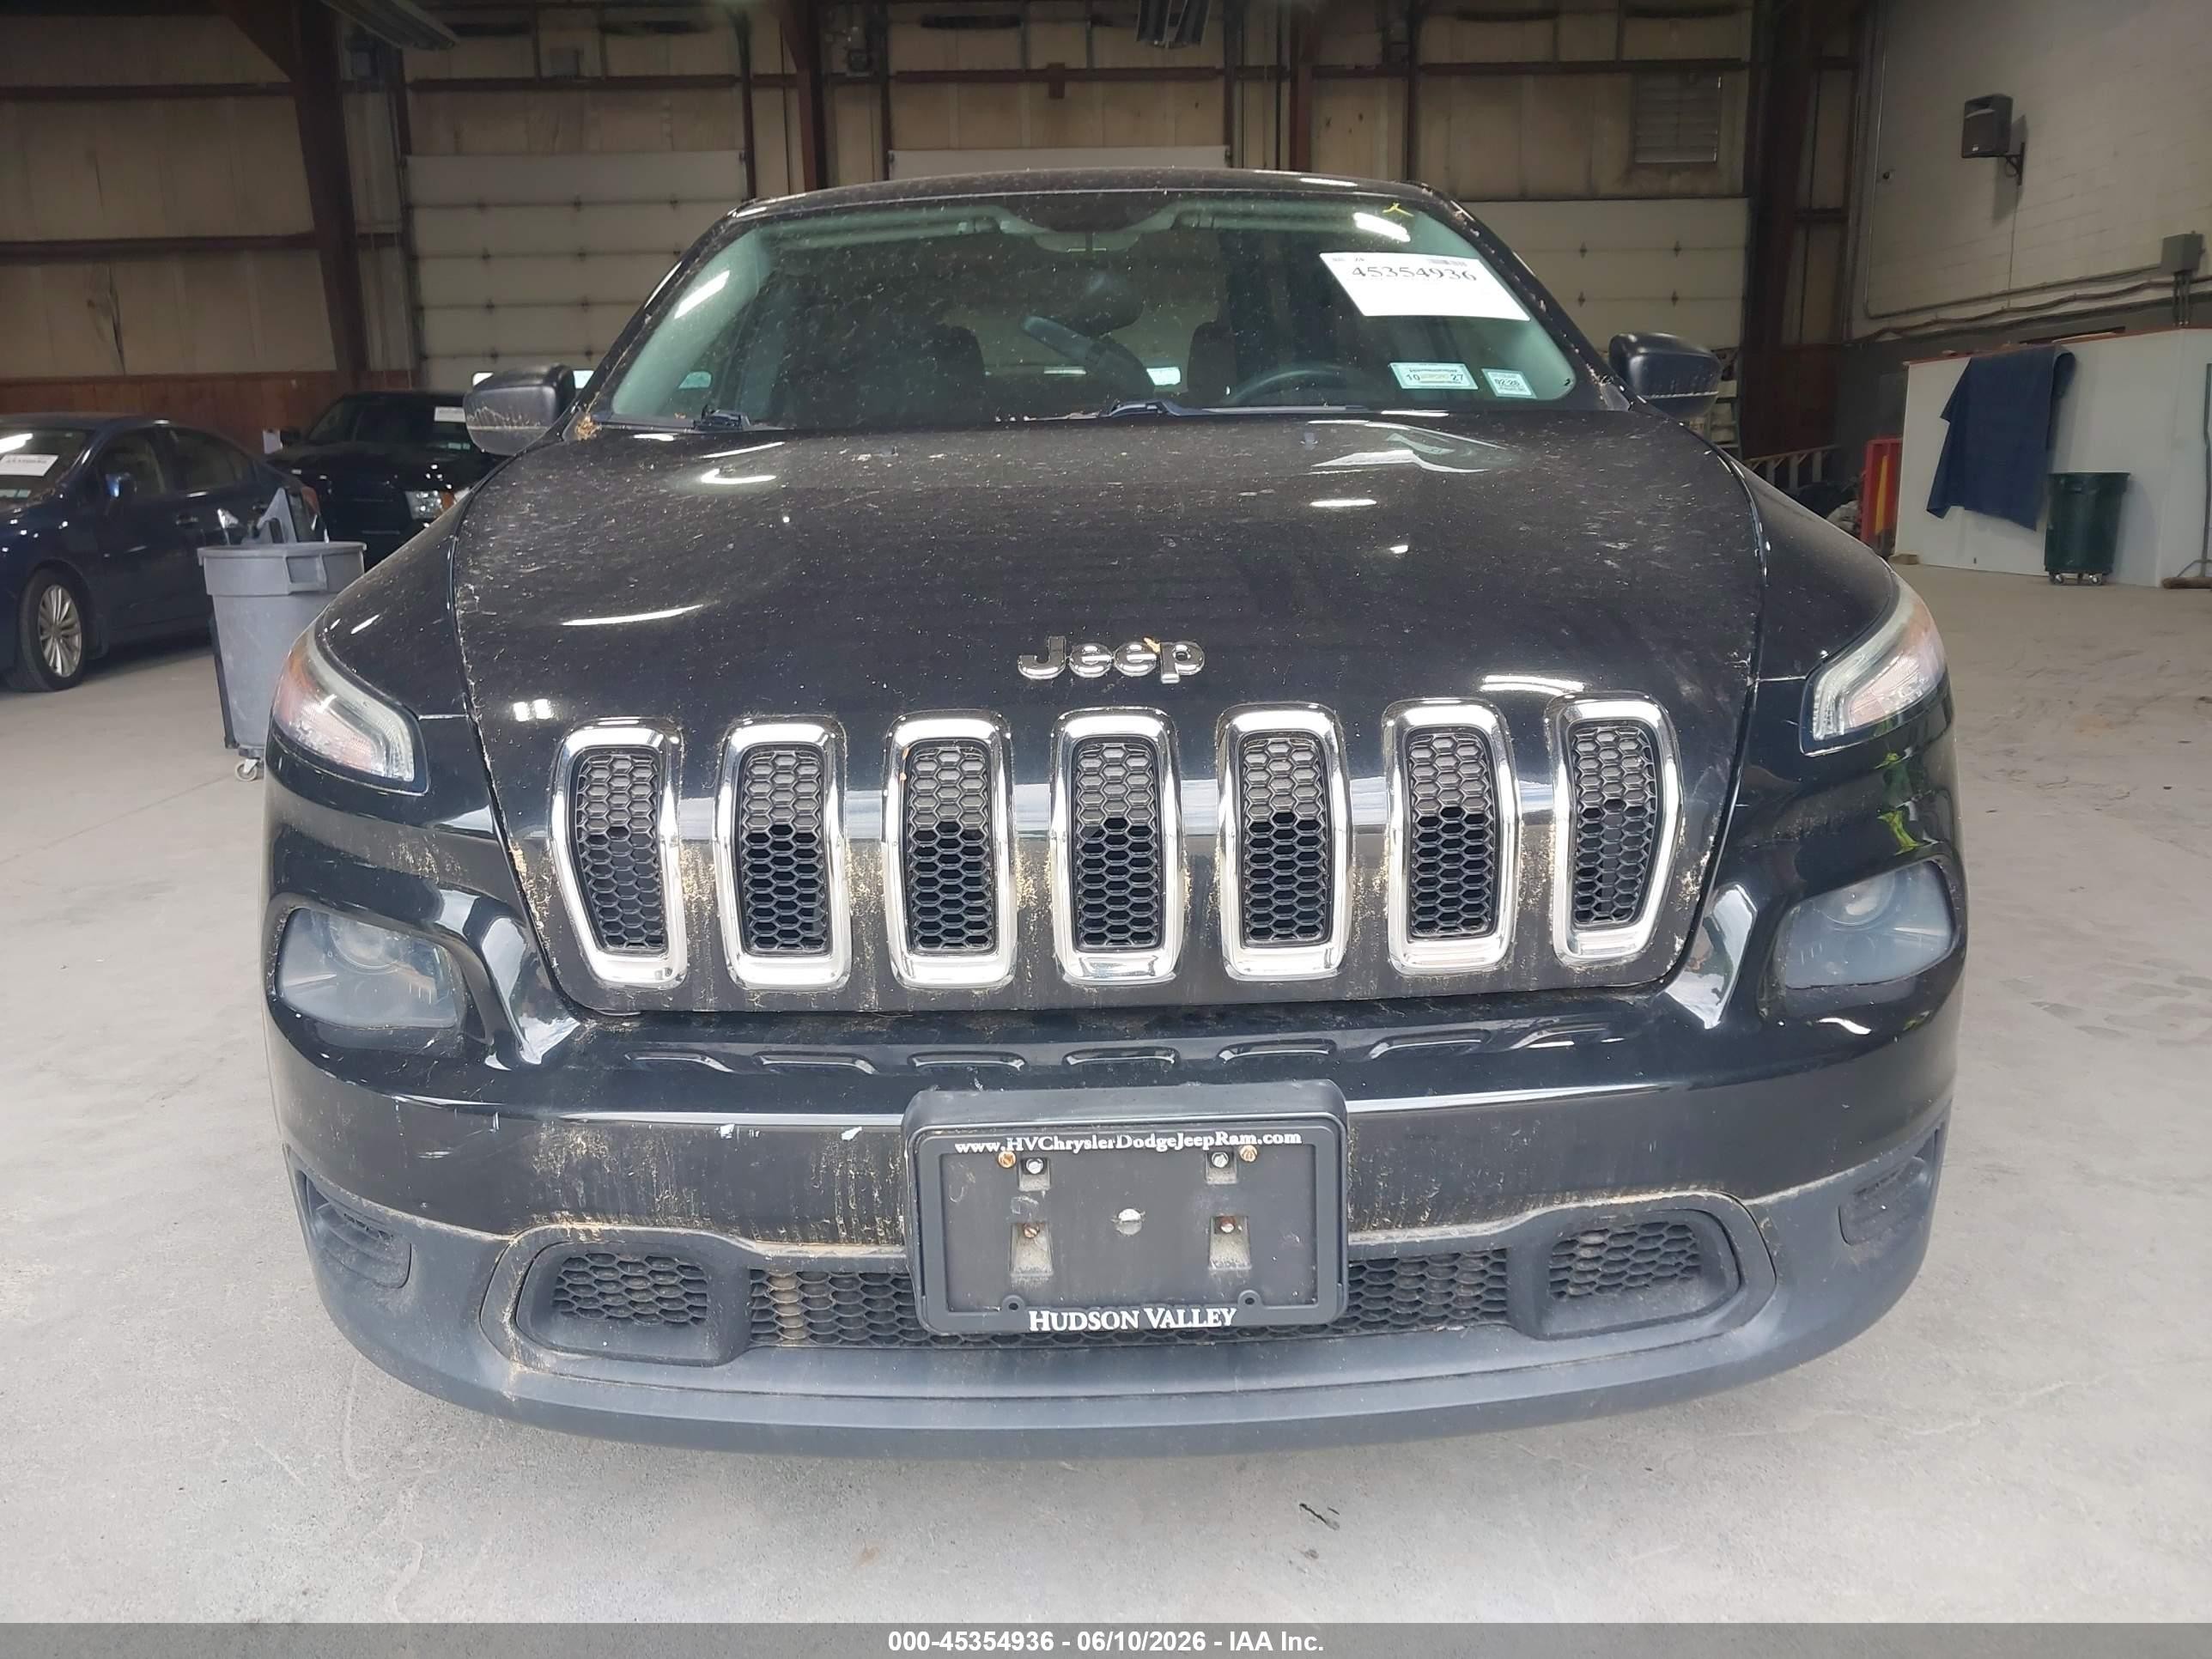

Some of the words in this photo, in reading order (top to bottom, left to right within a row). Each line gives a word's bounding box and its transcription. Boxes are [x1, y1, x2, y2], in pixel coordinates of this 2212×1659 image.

[1352, 266, 1477, 281] 45354936
[1018, 635, 1205, 684] Jeep
[955, 1131, 1302, 1153] www.HVChryslerDodgeJeepRam.com
[1029, 1310, 1139, 1331] HUDSON
[1144, 1307, 1237, 1329] VALLEY
